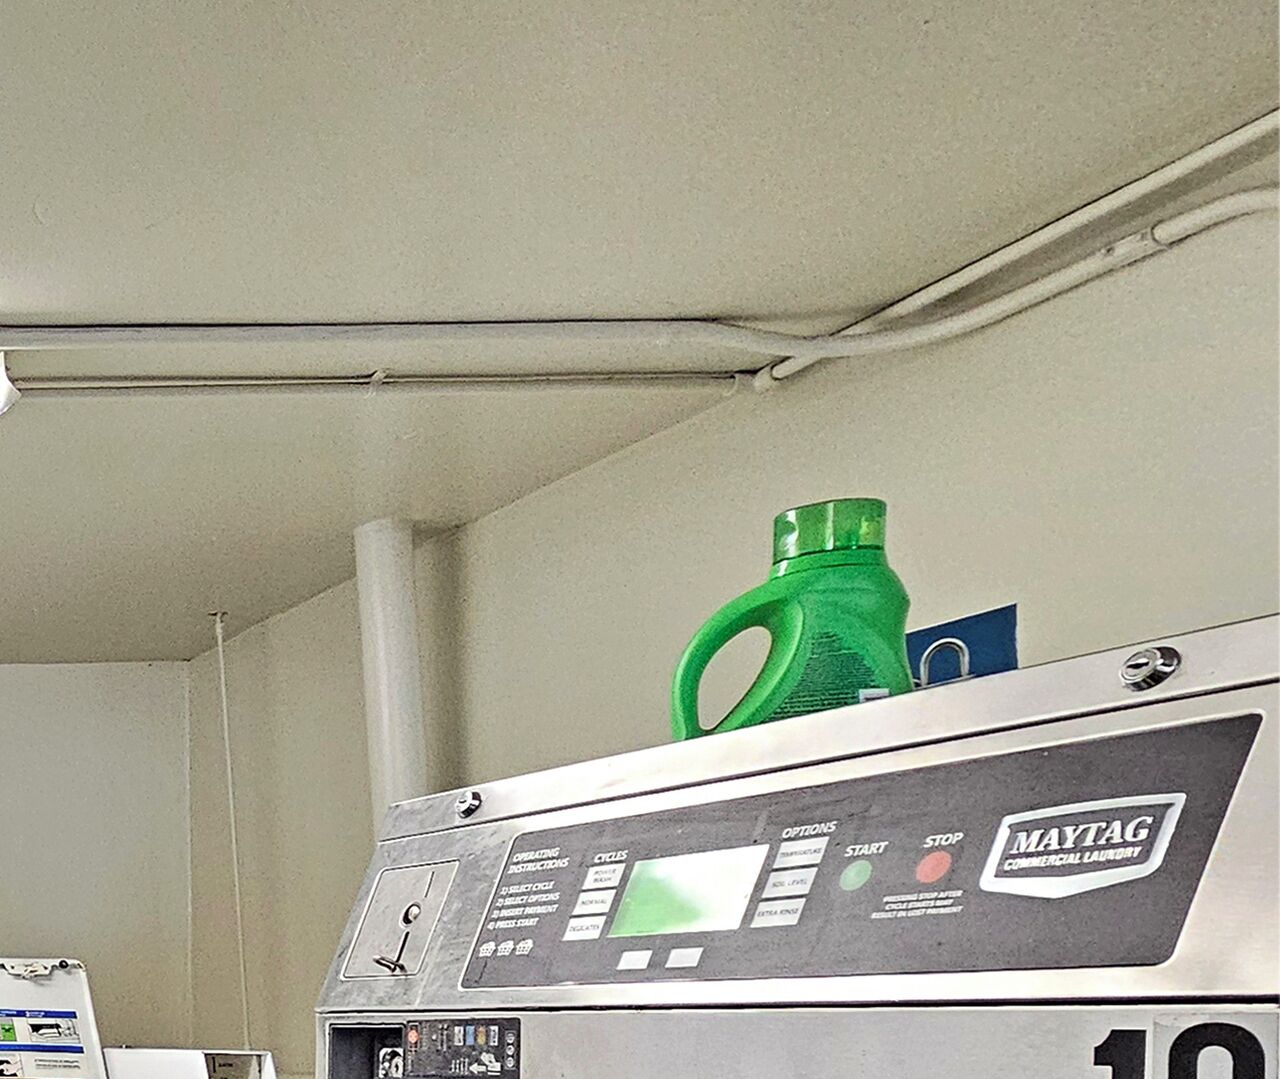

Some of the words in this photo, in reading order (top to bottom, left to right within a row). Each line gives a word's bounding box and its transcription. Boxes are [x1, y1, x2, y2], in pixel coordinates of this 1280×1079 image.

[782, 821, 838, 838] OPTIONS
[1009, 816, 1154, 855] MAYTAG
[923, 832, 964, 848] STOP
[513, 847, 560, 862] OPERATING
[594, 850, 628, 863] CYCLES
[844, 841, 889, 857] START
[507, 857, 570, 874] INSTRUCTIONS
[1003, 852, 1081, 871] COMMERCIAL
[1083, 846, 1143, 864] LAUNDRY
[508, 884, 533, 894] SELECT
[532, 881, 555, 890] CYCLE
[504, 896, 528, 905] SELECT
[528, 892, 560, 902] OPTIONS
